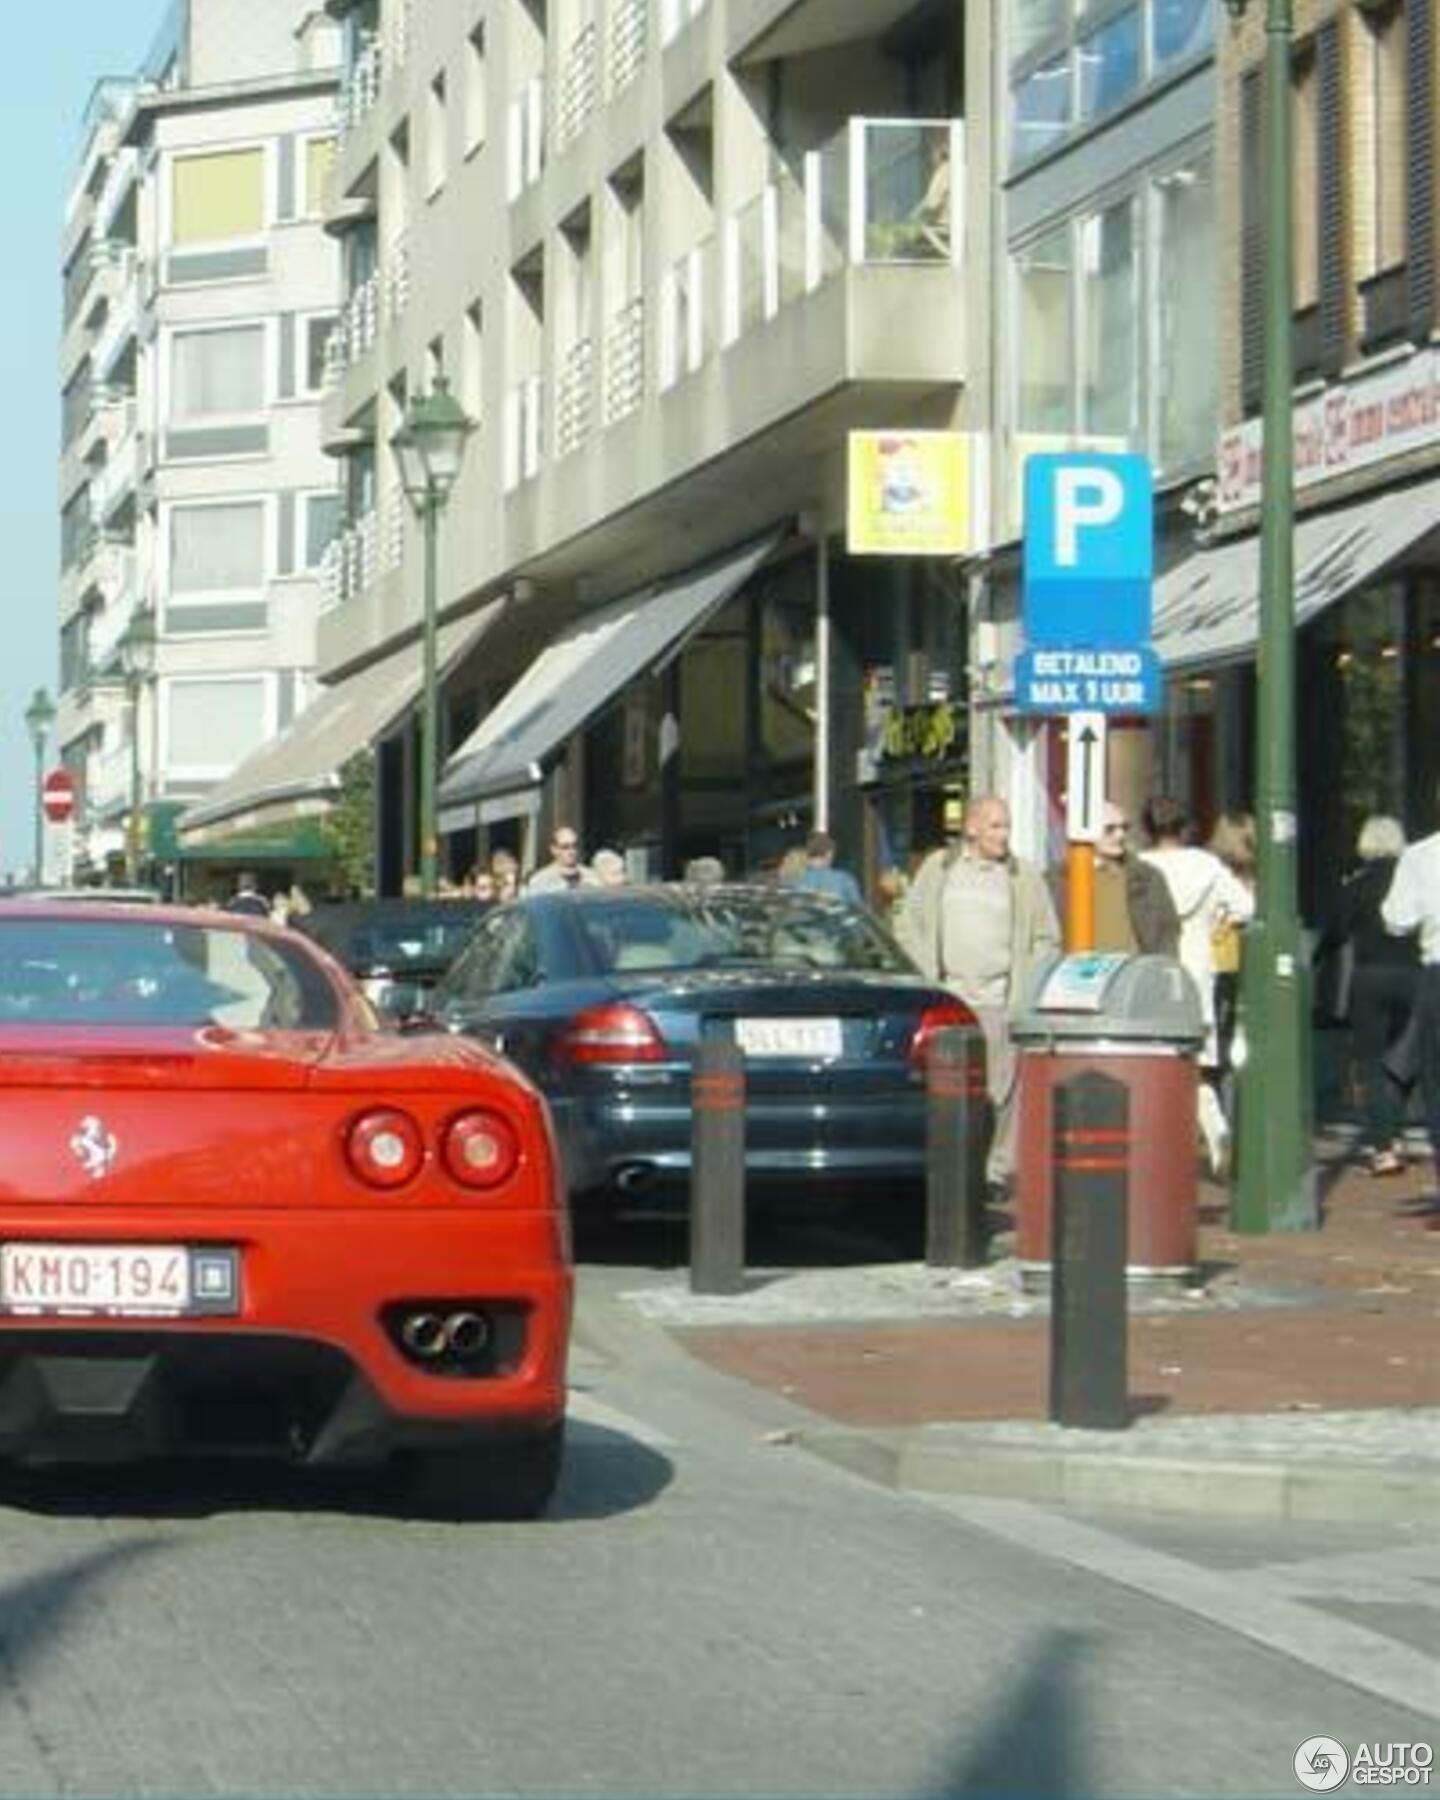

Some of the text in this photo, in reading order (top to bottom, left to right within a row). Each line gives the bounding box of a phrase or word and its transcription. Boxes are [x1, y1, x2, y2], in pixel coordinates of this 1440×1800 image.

[1055, 467, 1124, 567] P
[1033, 652, 1142, 676] BETALEND
[1030, 679, 1146, 704] MAX 1 UUR
